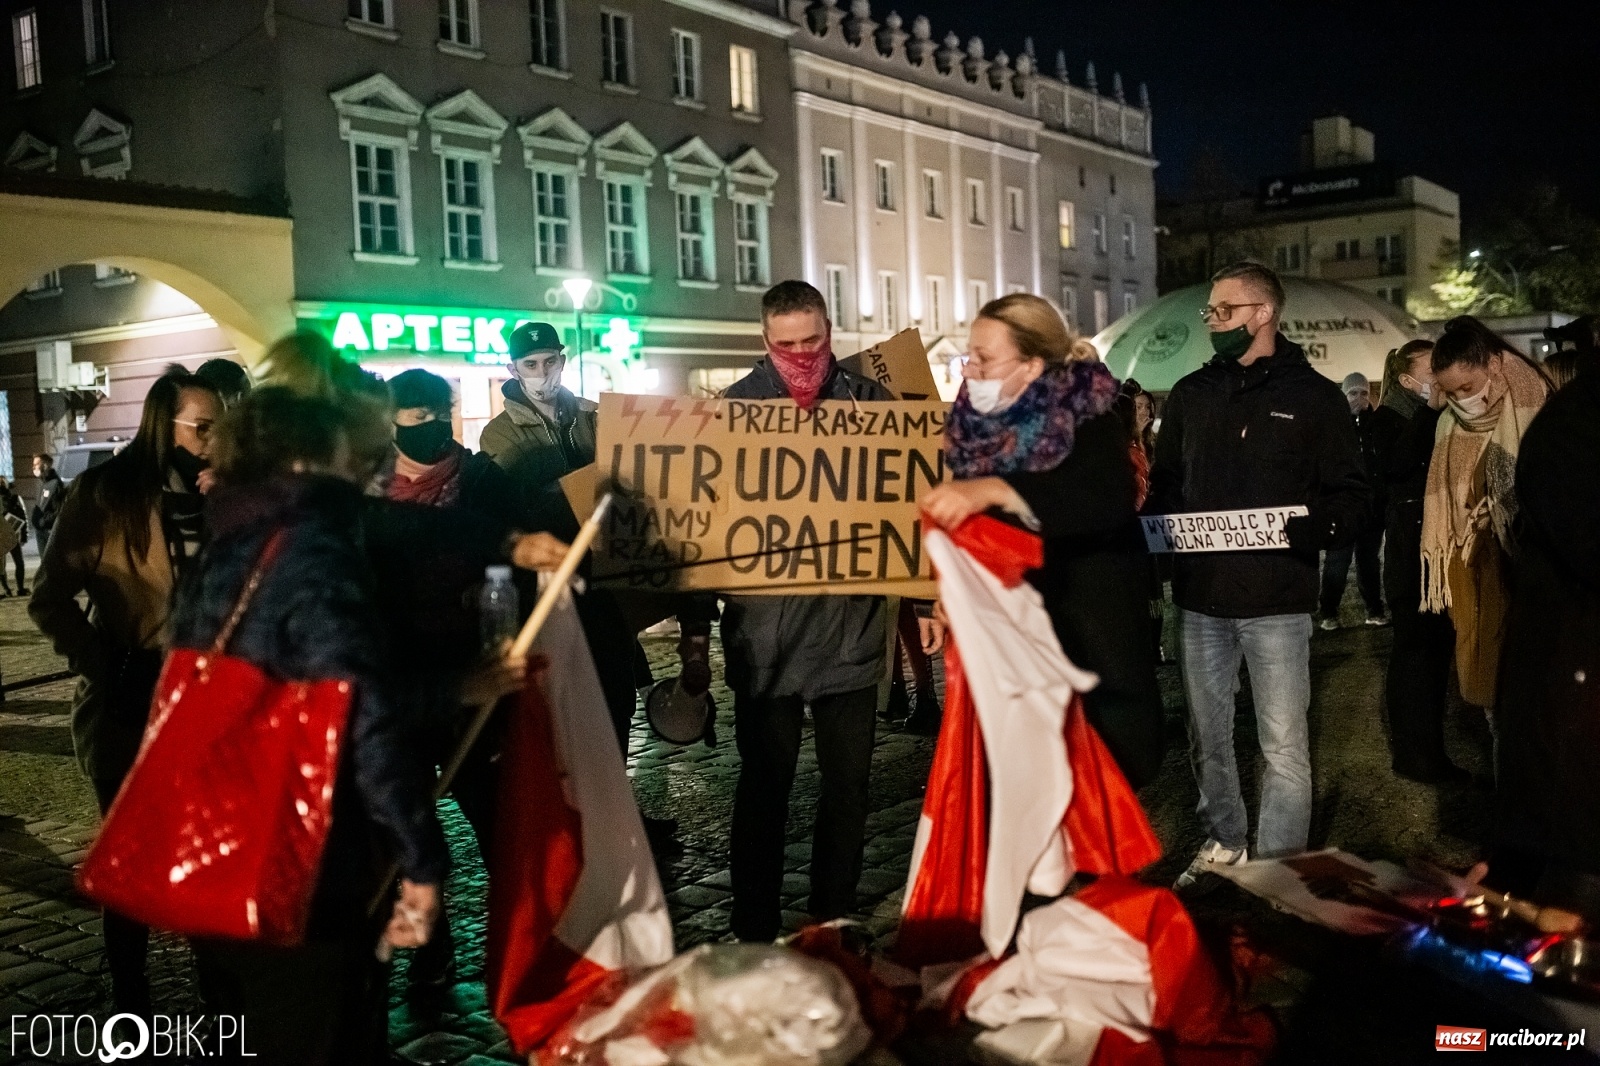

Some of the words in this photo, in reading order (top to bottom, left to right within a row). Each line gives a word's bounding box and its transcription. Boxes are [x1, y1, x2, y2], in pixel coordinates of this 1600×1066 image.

[331, 311, 532, 353] APTEK
[728, 401, 945, 439] PRZEPRASZAMY
[611, 443, 945, 503] UTRUDNIEN
[609, 505, 712, 540] MAMY
[725, 514, 938, 581] OBALEN
[1164, 533, 1215, 551] WOLNA
[1223, 529, 1290, 548] POLSKA
